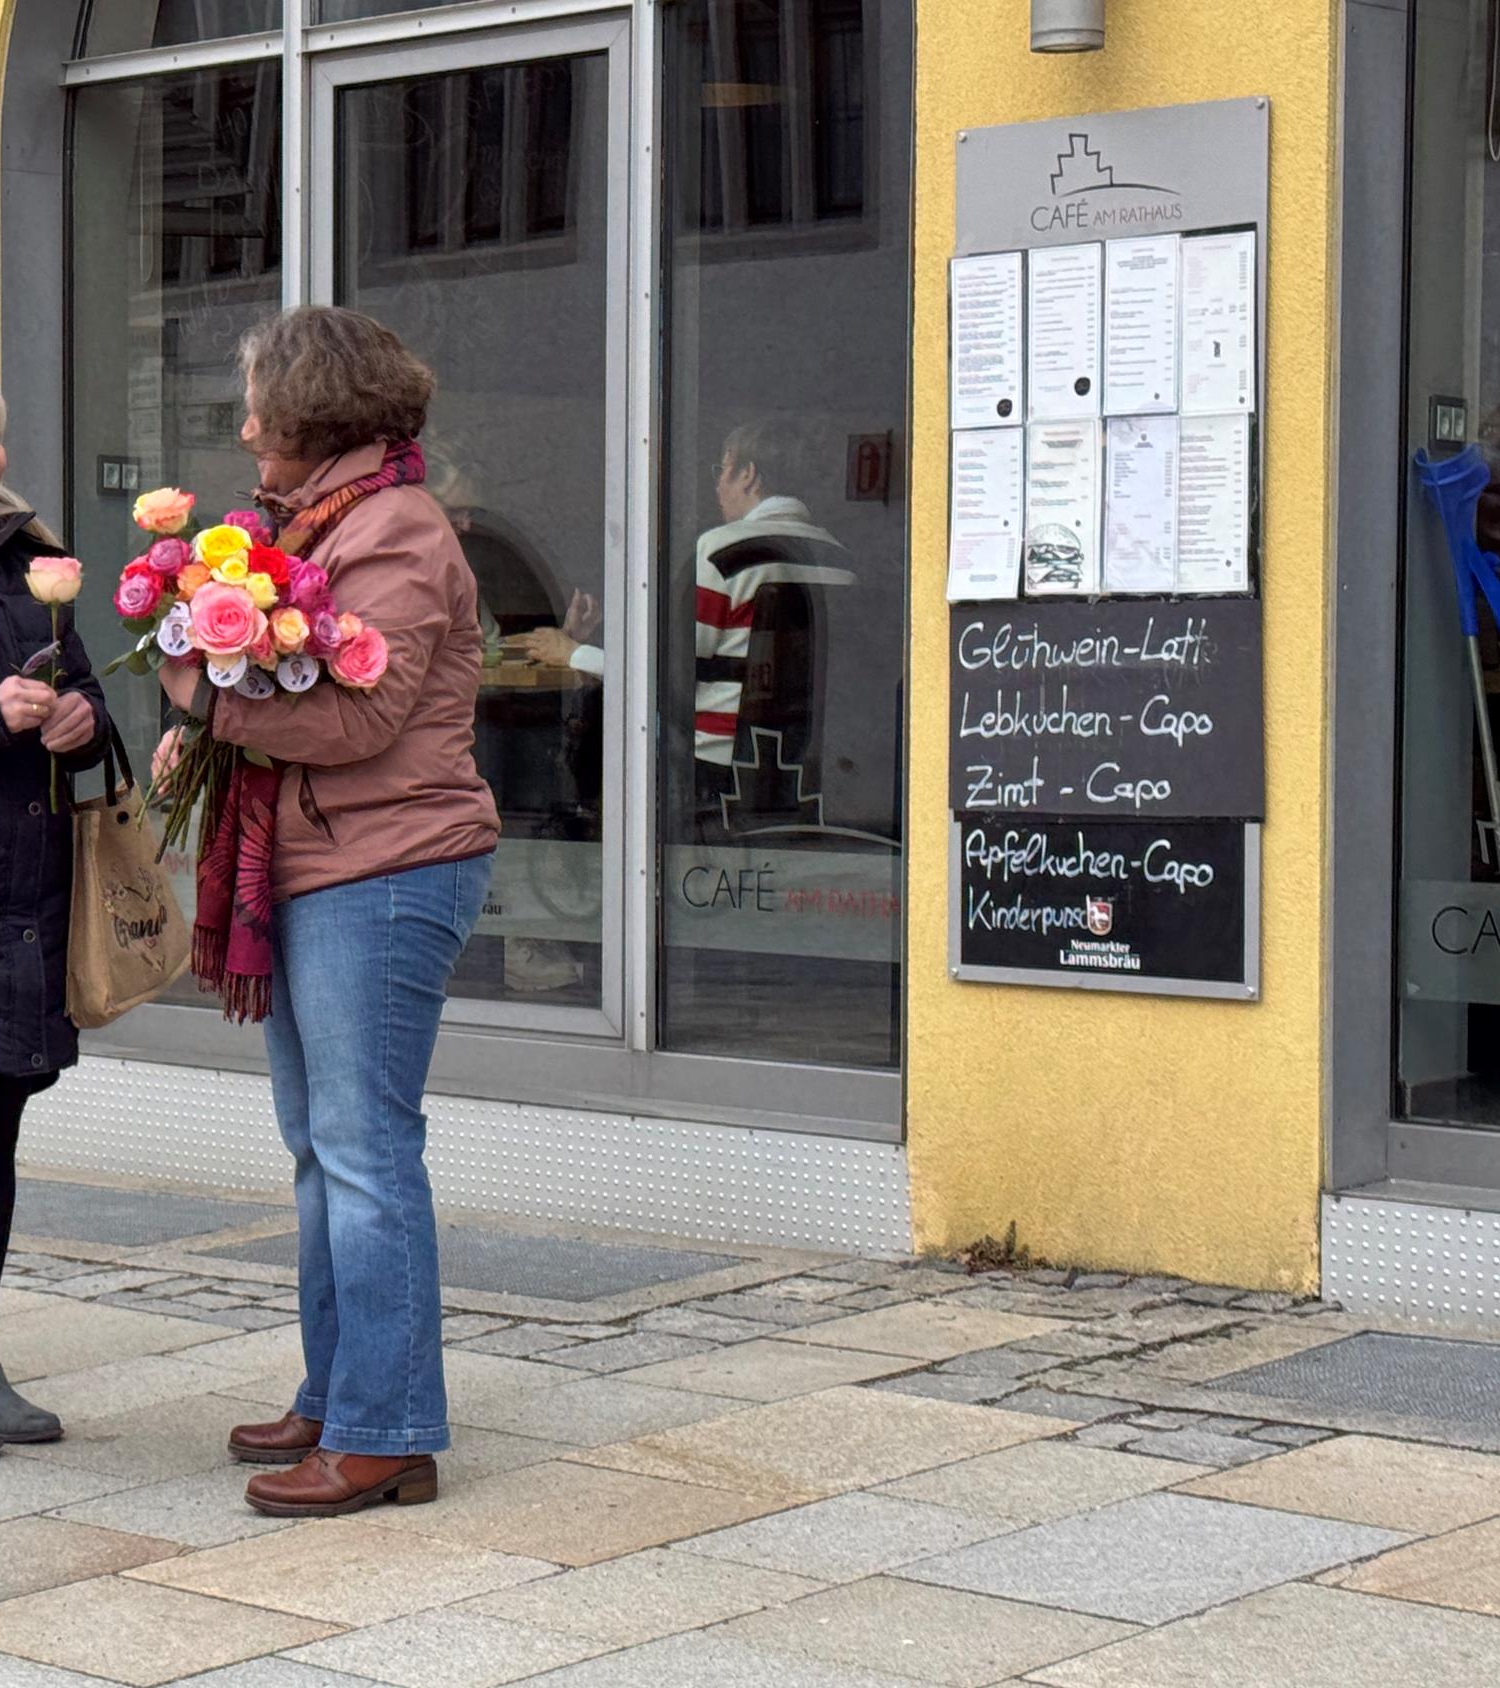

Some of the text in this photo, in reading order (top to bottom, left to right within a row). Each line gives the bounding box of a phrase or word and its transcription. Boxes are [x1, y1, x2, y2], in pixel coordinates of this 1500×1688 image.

[1030, 198, 1183, 231] CAFÉ AM RATHAUS
[682, 862, 775, 912] CAFÉ
[1059, 949, 1141, 970] Lammsbräu
[1070, 938, 1131, 954] Neumarkter
